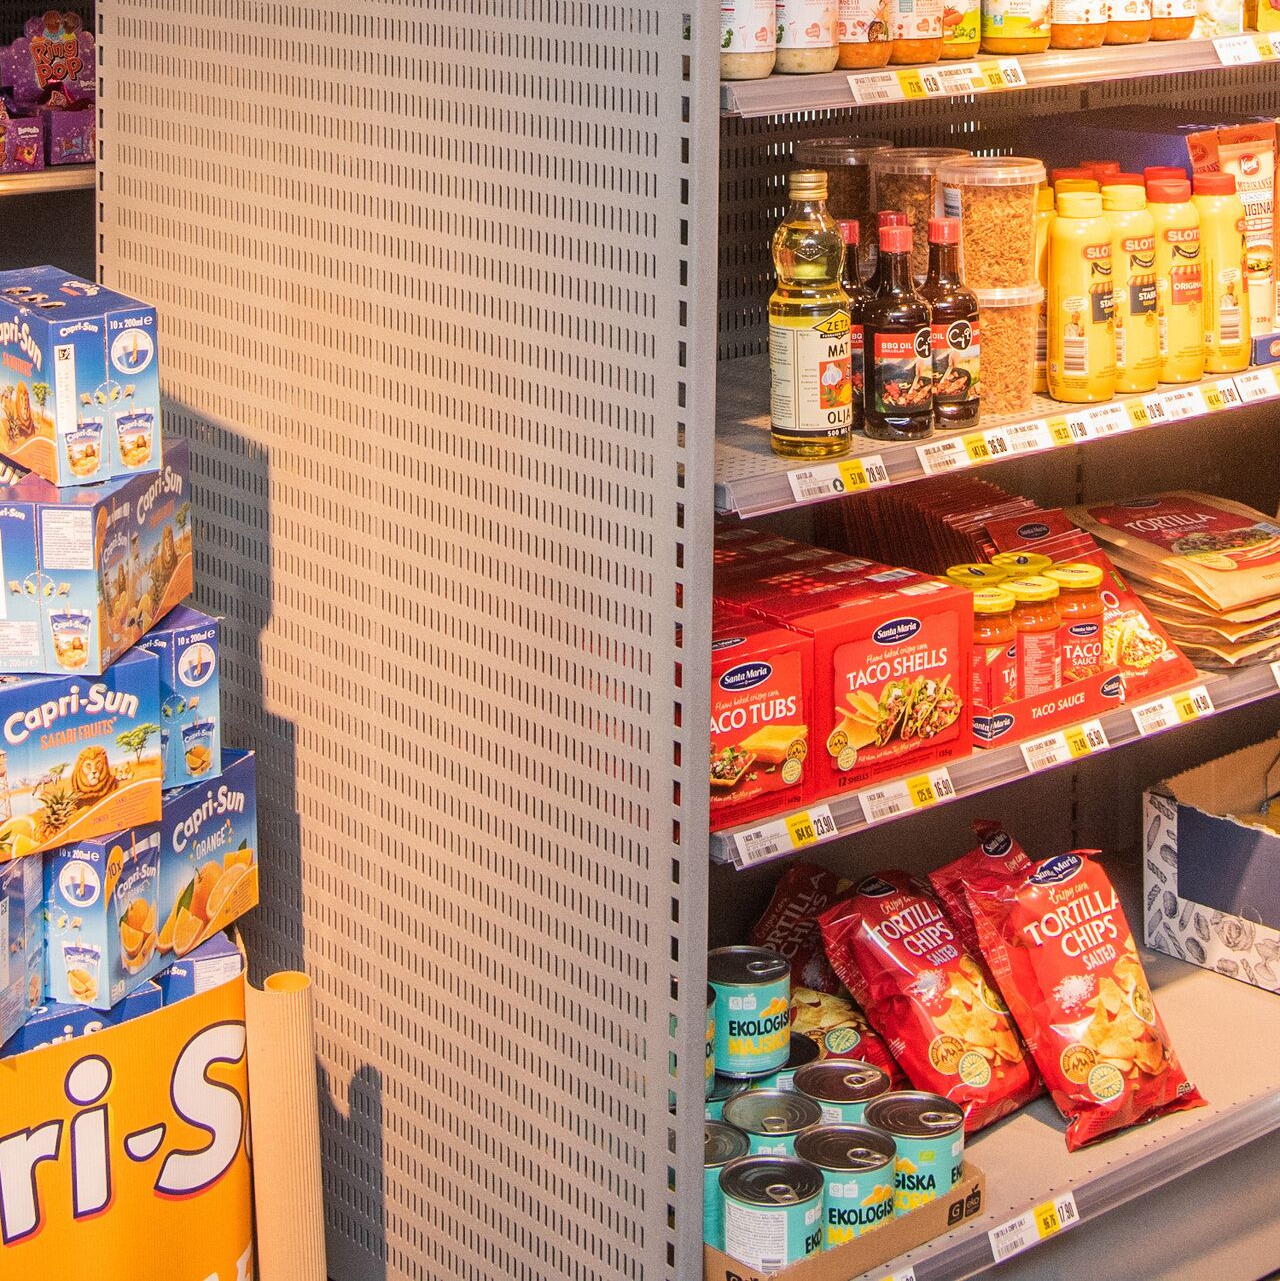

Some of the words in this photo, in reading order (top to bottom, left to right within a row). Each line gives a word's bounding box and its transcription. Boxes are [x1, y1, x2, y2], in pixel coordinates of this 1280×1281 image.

[60, 322, 98, 337] Capri-Sun
[828, 410, 851, 424] OLJA
[989, 437, 1006, 454] 36.90
[865, 466, 886, 482] 28.90
[136, 470, 183, 526] Capri-Sun
[1123, 509, 1217, 534] TORTILLA
[1064, 643, 1101, 658] TACO
[1073, 656, 1097, 666] SAUCE
[847, 664, 891, 691] TACO
[893, 647, 948, 677] SHELLS
[3, 683, 139, 746] Capri-Sun
[750, 696, 796, 725] TUBS
[1032, 703, 1055, 719] TACO
[1058, 692, 1085, 711] SAUCE
[40, 728, 77, 750] SAFARI
[934, 773, 953, 794] 16.90
[172, 791, 245, 853] Capri-Sun
[813, 816, 834, 836] 23.90
[1023, 886, 1120, 946] TORTILLA
[903, 922, 954, 955] CHIPS
[1061, 915, 1117, 957] CHIPS
[926, 944, 958, 966] SALTED
[1082, 944, 1116, 970] SALTED
